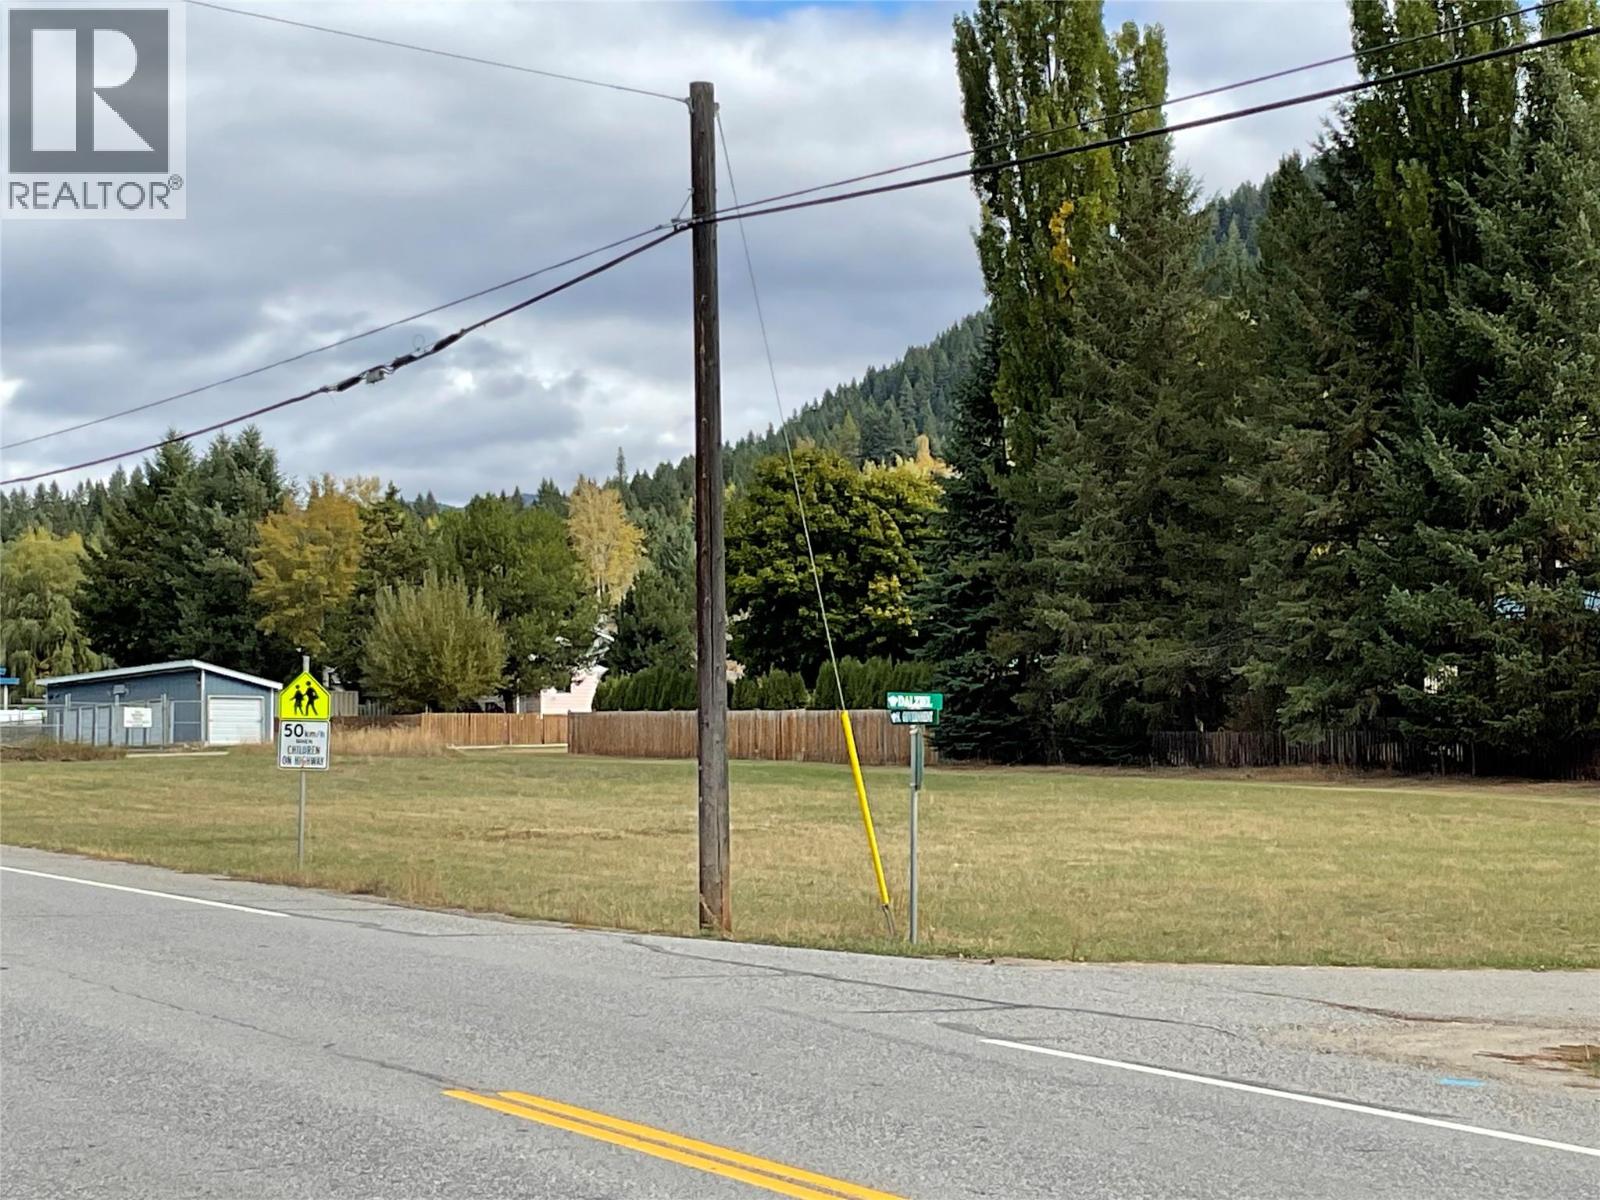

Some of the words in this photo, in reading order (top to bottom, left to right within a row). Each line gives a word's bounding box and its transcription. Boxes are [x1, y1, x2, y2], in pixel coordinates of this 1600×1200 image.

[284, 723, 304, 738] 50
[305, 730, 325, 738] km/h
[287, 745, 321, 755] CHILDREN
[282, 755, 292, 765] ON
